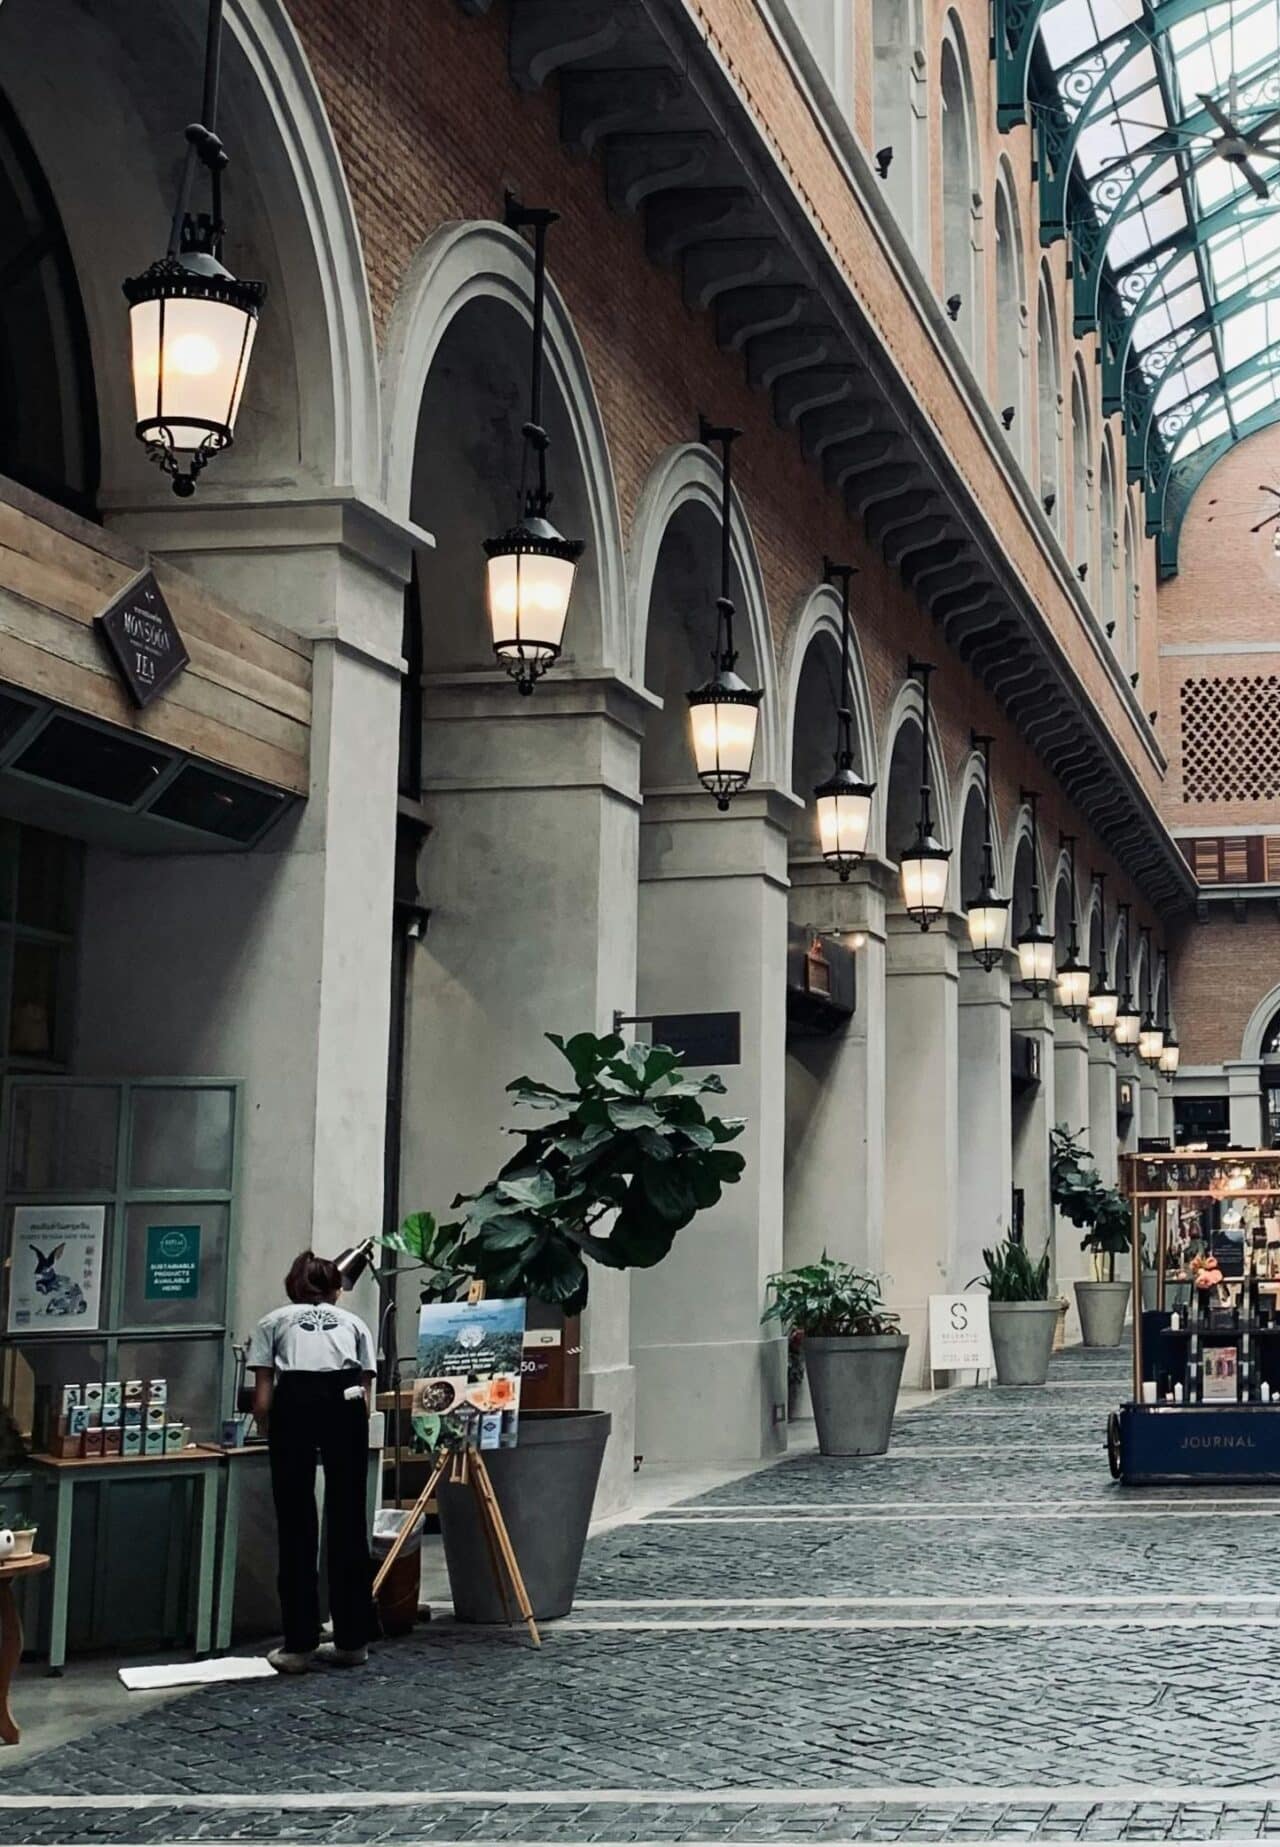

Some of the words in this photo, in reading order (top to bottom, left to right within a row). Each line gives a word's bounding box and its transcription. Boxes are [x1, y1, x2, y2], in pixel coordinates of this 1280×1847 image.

[124, 612, 170, 650] MONSOON
[136, 652, 156, 680] TEA
[950, 1303, 968, 1330] S
[1181, 1436, 1257, 1449] JOURNAL
